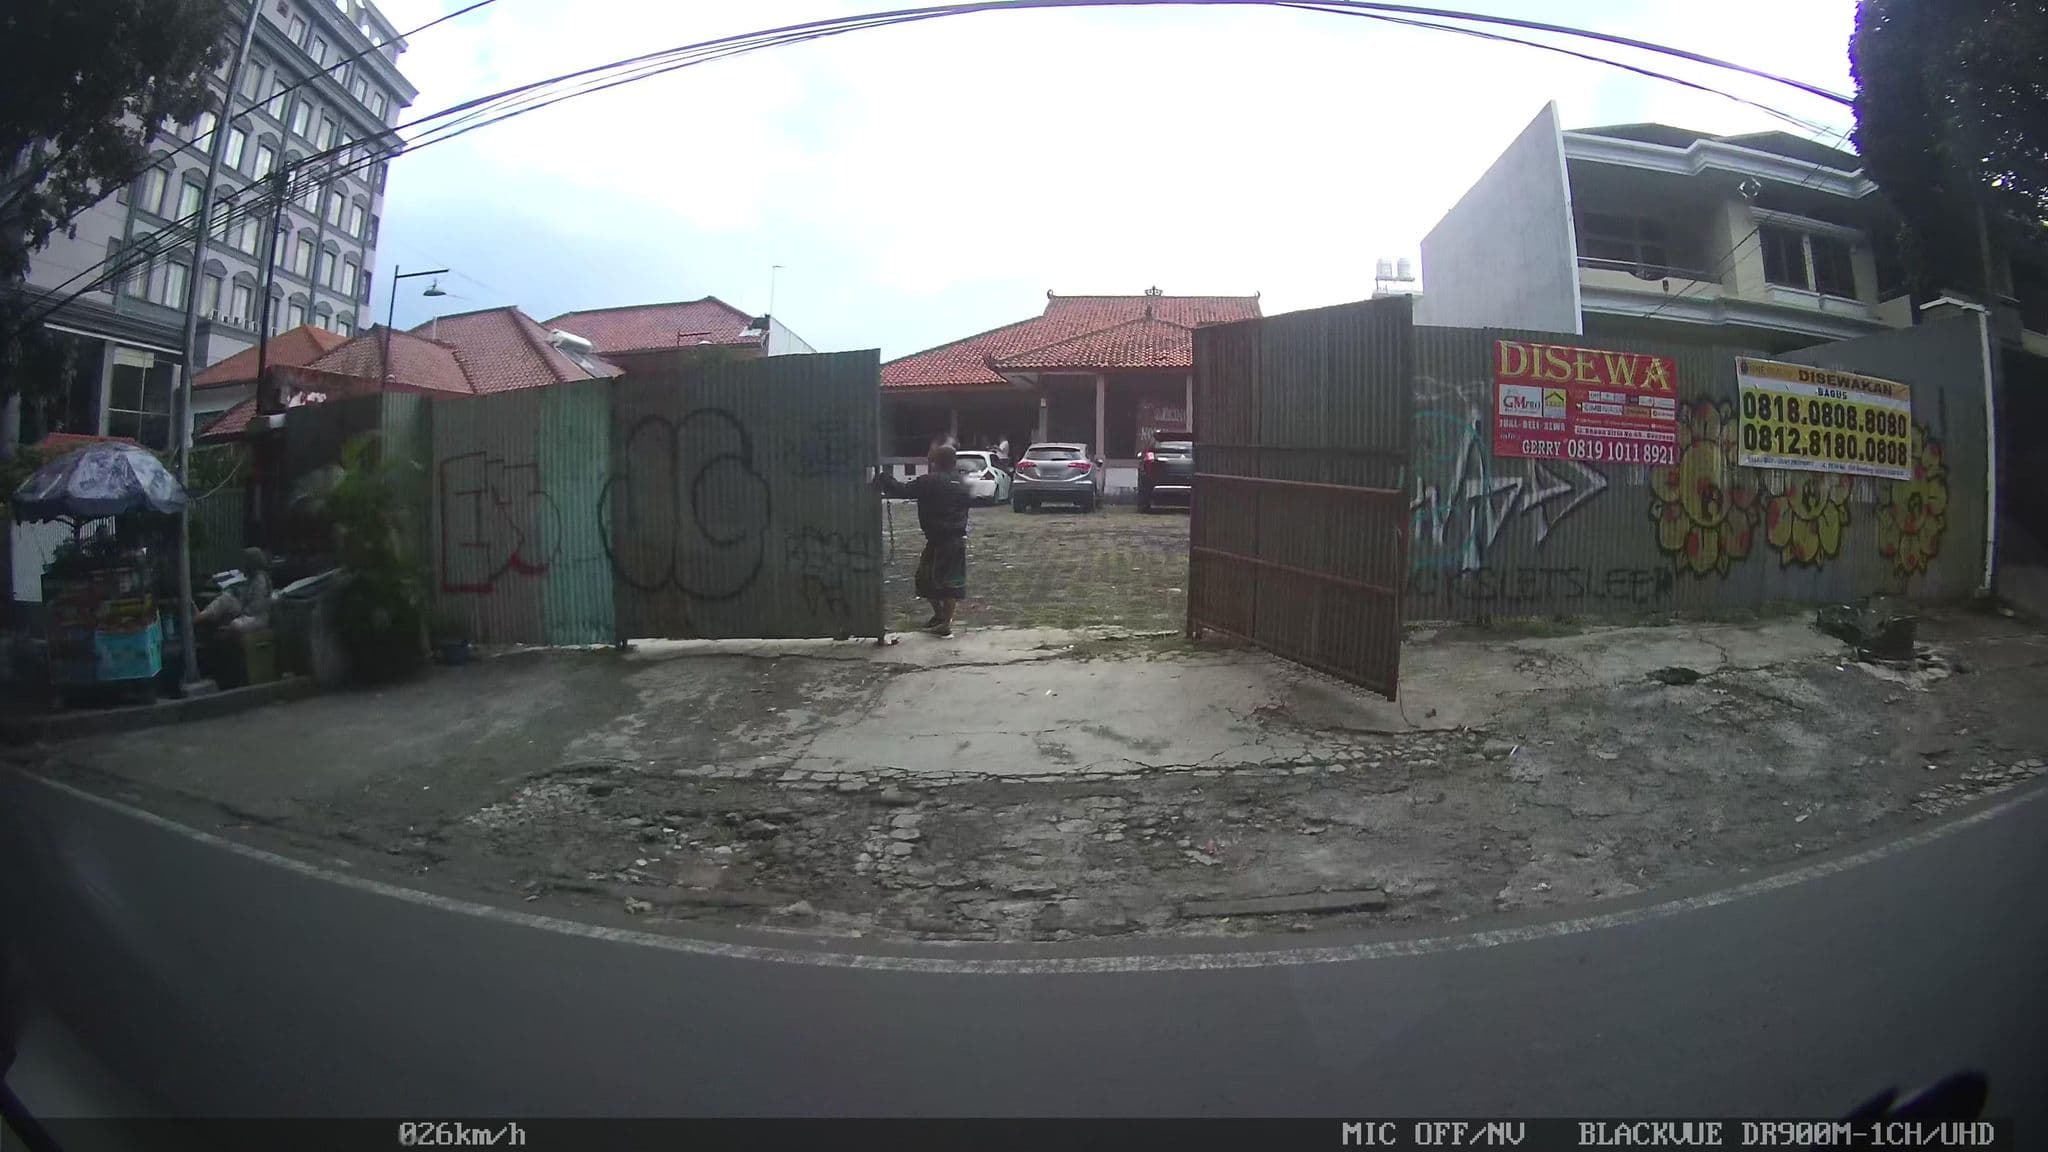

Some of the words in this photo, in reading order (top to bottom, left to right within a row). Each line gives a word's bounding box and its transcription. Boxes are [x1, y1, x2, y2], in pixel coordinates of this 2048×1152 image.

[1499, 340, 1672, 391] DISEWA
[1799, 369, 1893, 396] DISEWAKAN
[1817, 387, 1848, 400] BAGUS
[1743, 391, 1908, 439] 0818.0808.8080
[1522, 440, 1561, 456] GERRY
[1567, 439, 1604, 460] 0819
[1608, 441, 1640, 462] 1011
[1643, 444, 1675, 465] 8921
[1743, 423, 1908, 466] 0812.8180.0808
